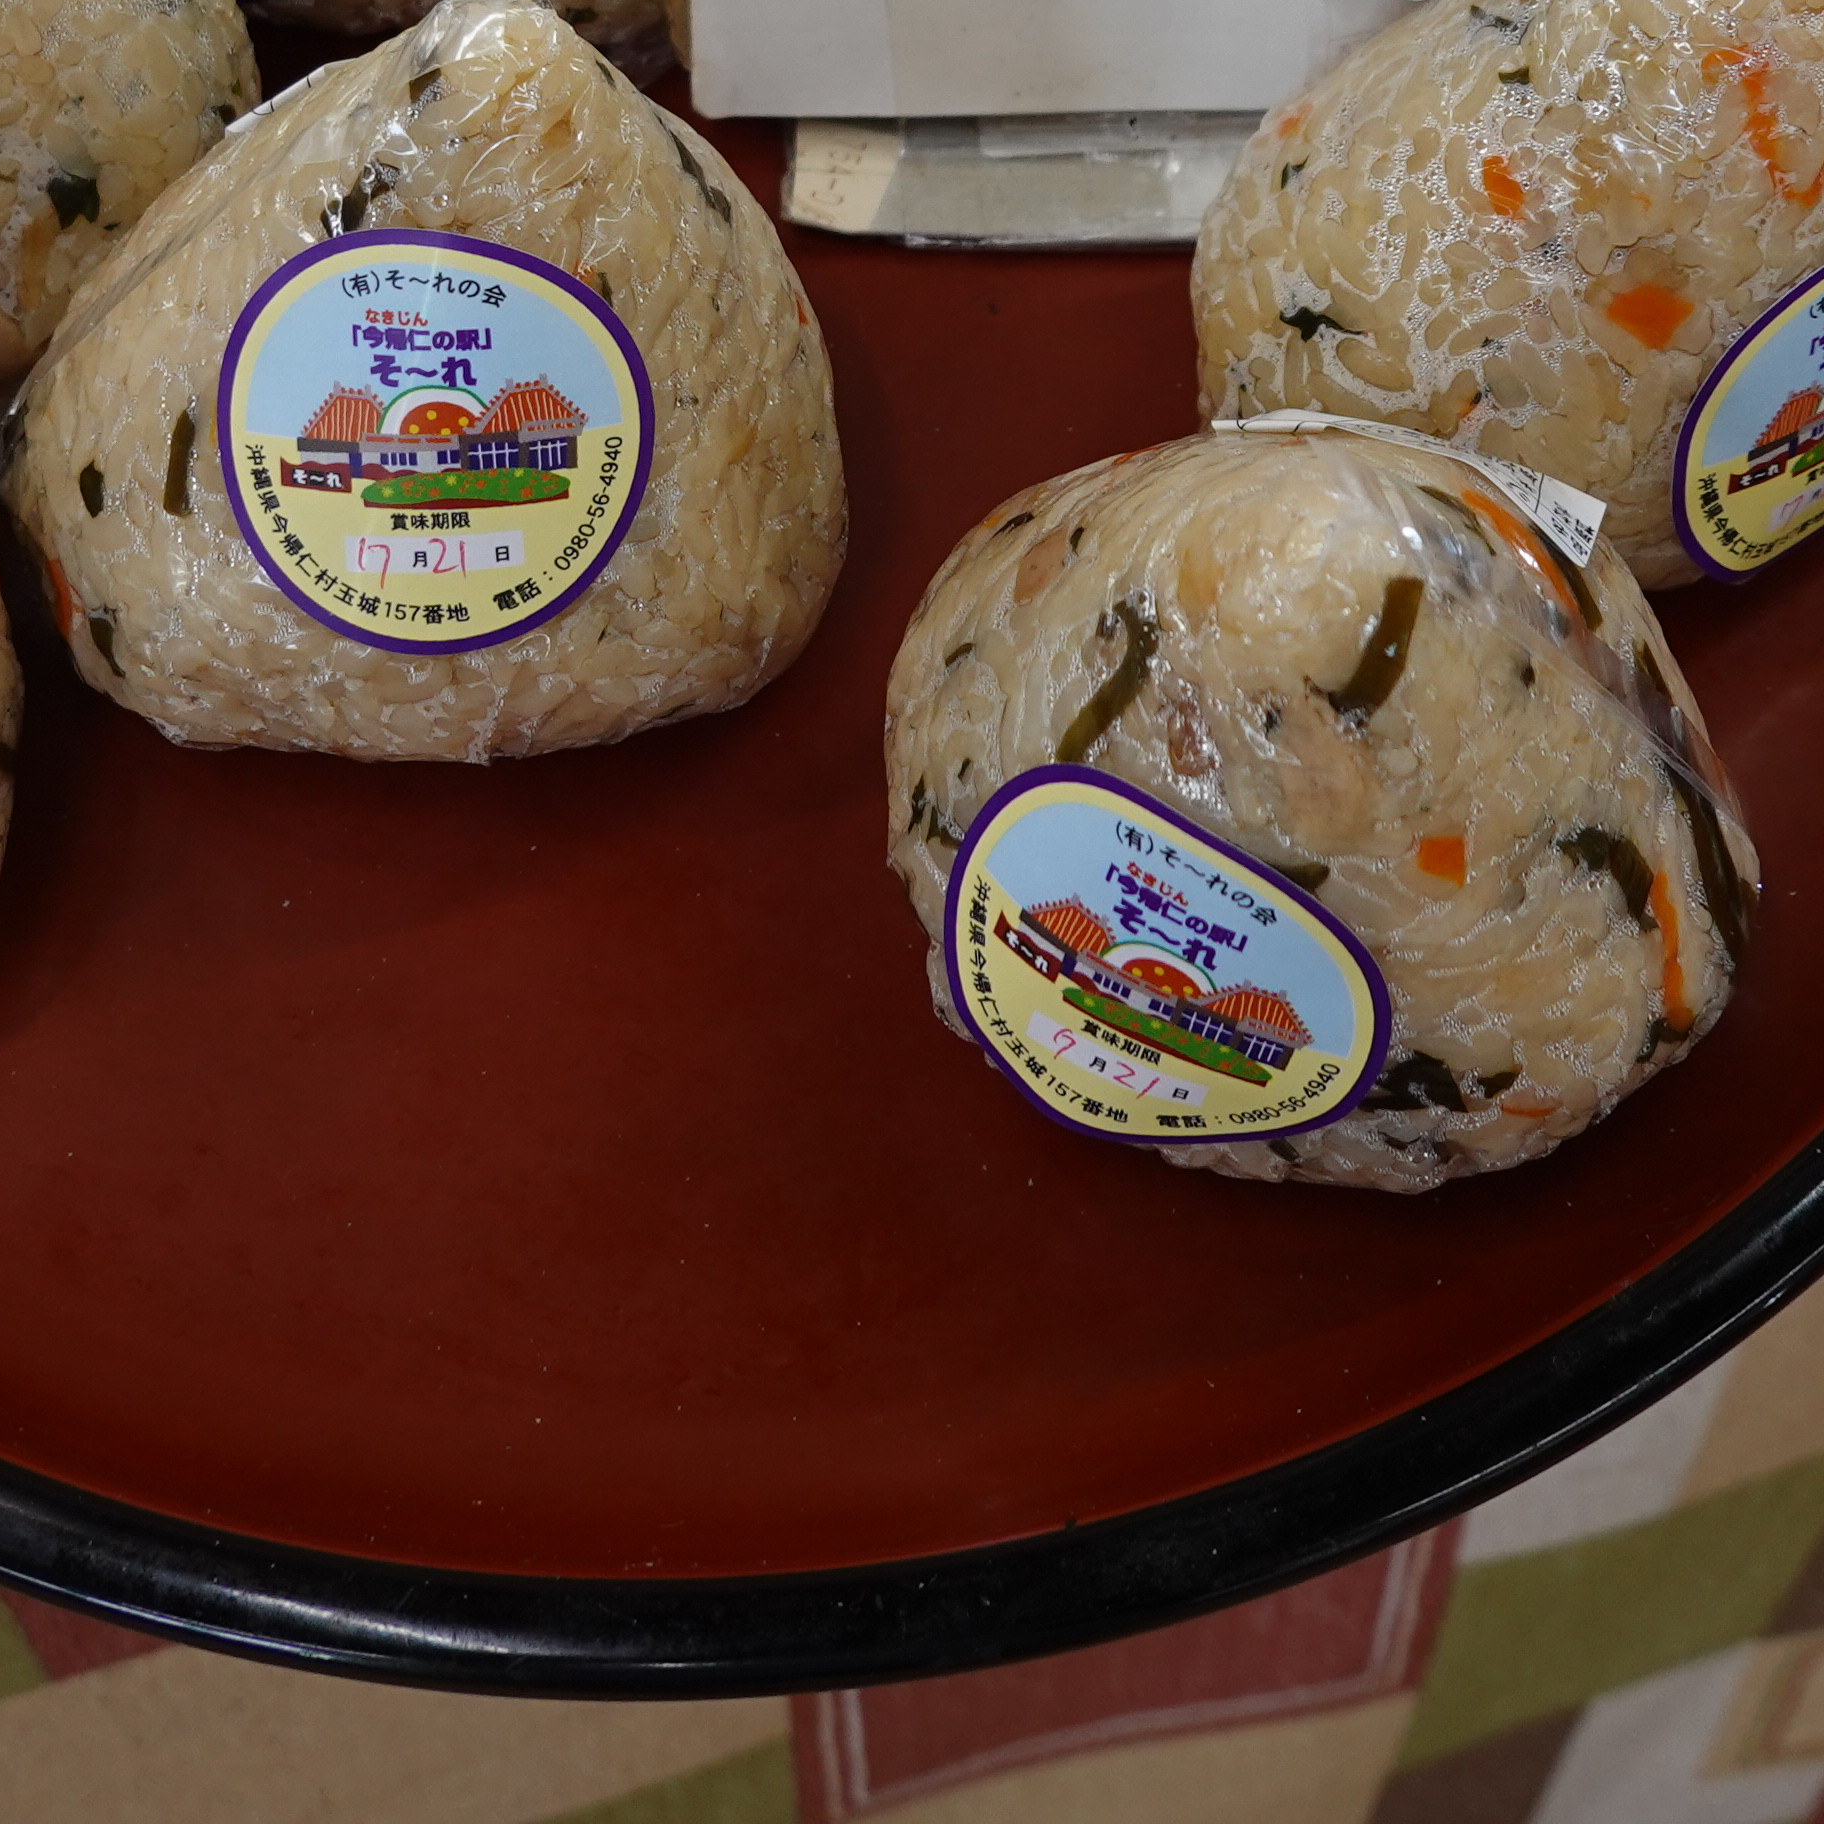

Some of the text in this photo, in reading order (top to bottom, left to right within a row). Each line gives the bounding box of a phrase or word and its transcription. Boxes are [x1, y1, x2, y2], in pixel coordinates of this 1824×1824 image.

[365, 309, 428, 326] なきじん
[244, 443, 471, 624] 沖縄県今帰仁村玉城157番地
[390, 511, 471, 530] 賞味期限
[1126, 860, 1189, 907] なきじん
[970, 874, 1129, 1124] 沖縄県今帰仁村玉城157番地
[1081, 1019, 1162, 1066] 賞味期限
